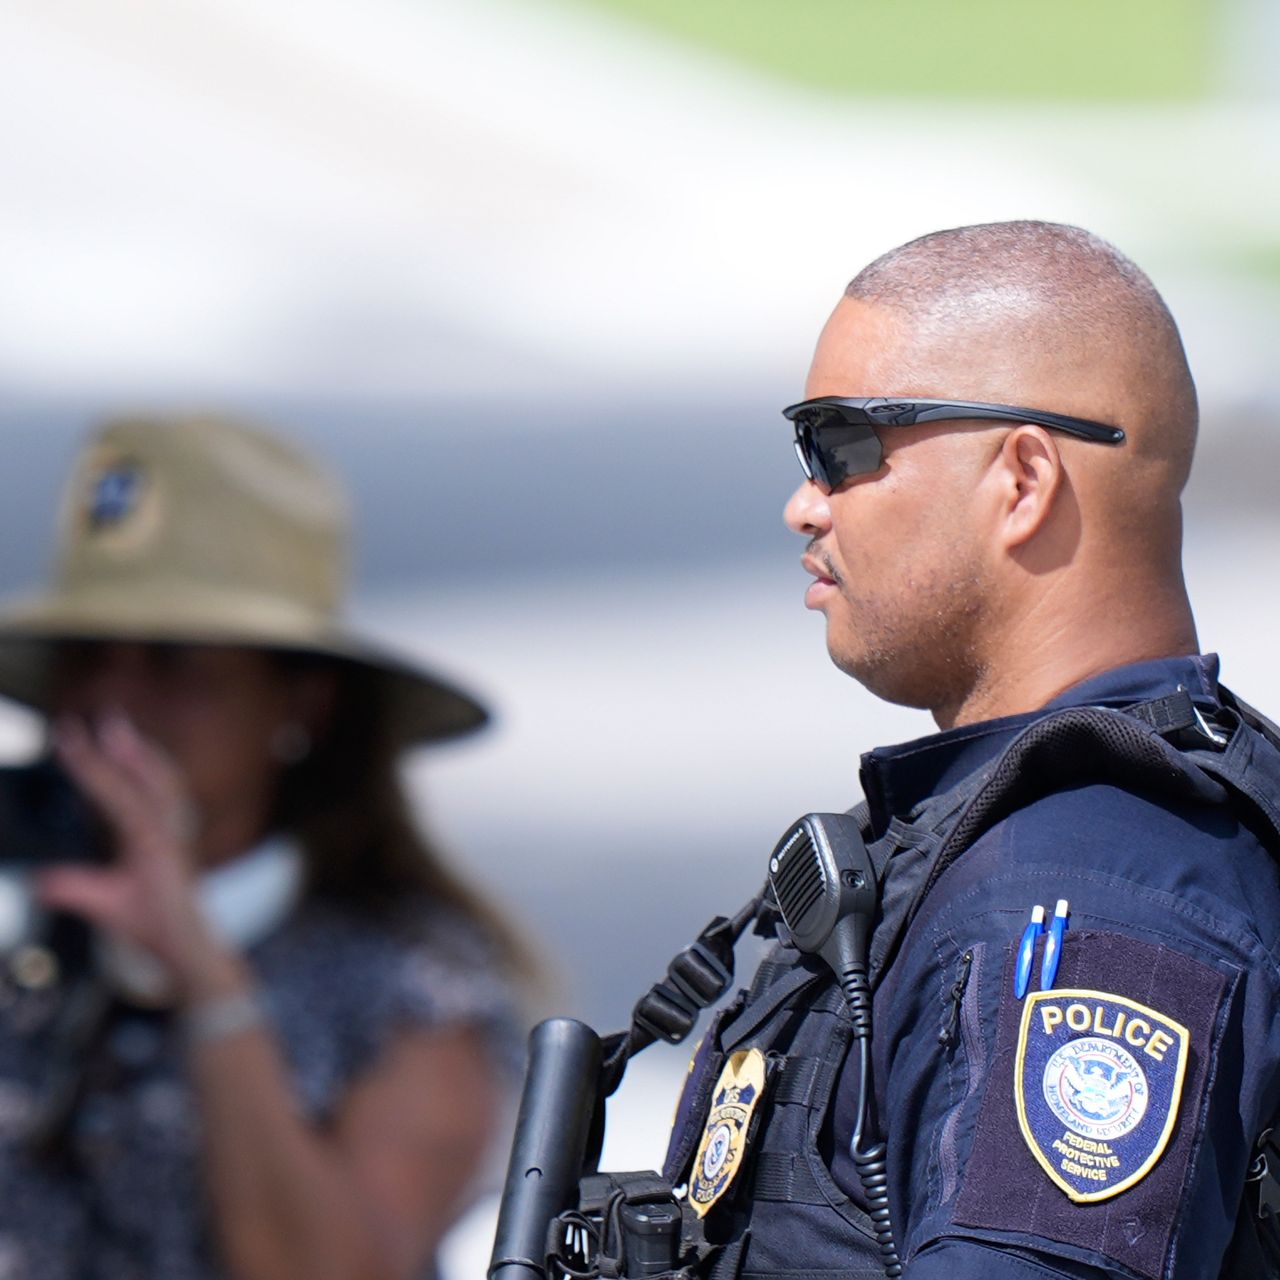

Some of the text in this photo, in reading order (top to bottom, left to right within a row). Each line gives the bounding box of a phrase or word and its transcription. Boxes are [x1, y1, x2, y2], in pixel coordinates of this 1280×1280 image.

[1040, 1003, 1174, 1061] POLICE
[1072, 1042, 1140, 1079] DEPARTMENT
[1048, 1084, 1093, 1135] HOMELAND
[1052, 1140, 1120, 1168] PROTECTIVE
[1062, 1131, 1113, 1154] FEDERAL
[1060, 1159, 1107, 1181] SERVICE
